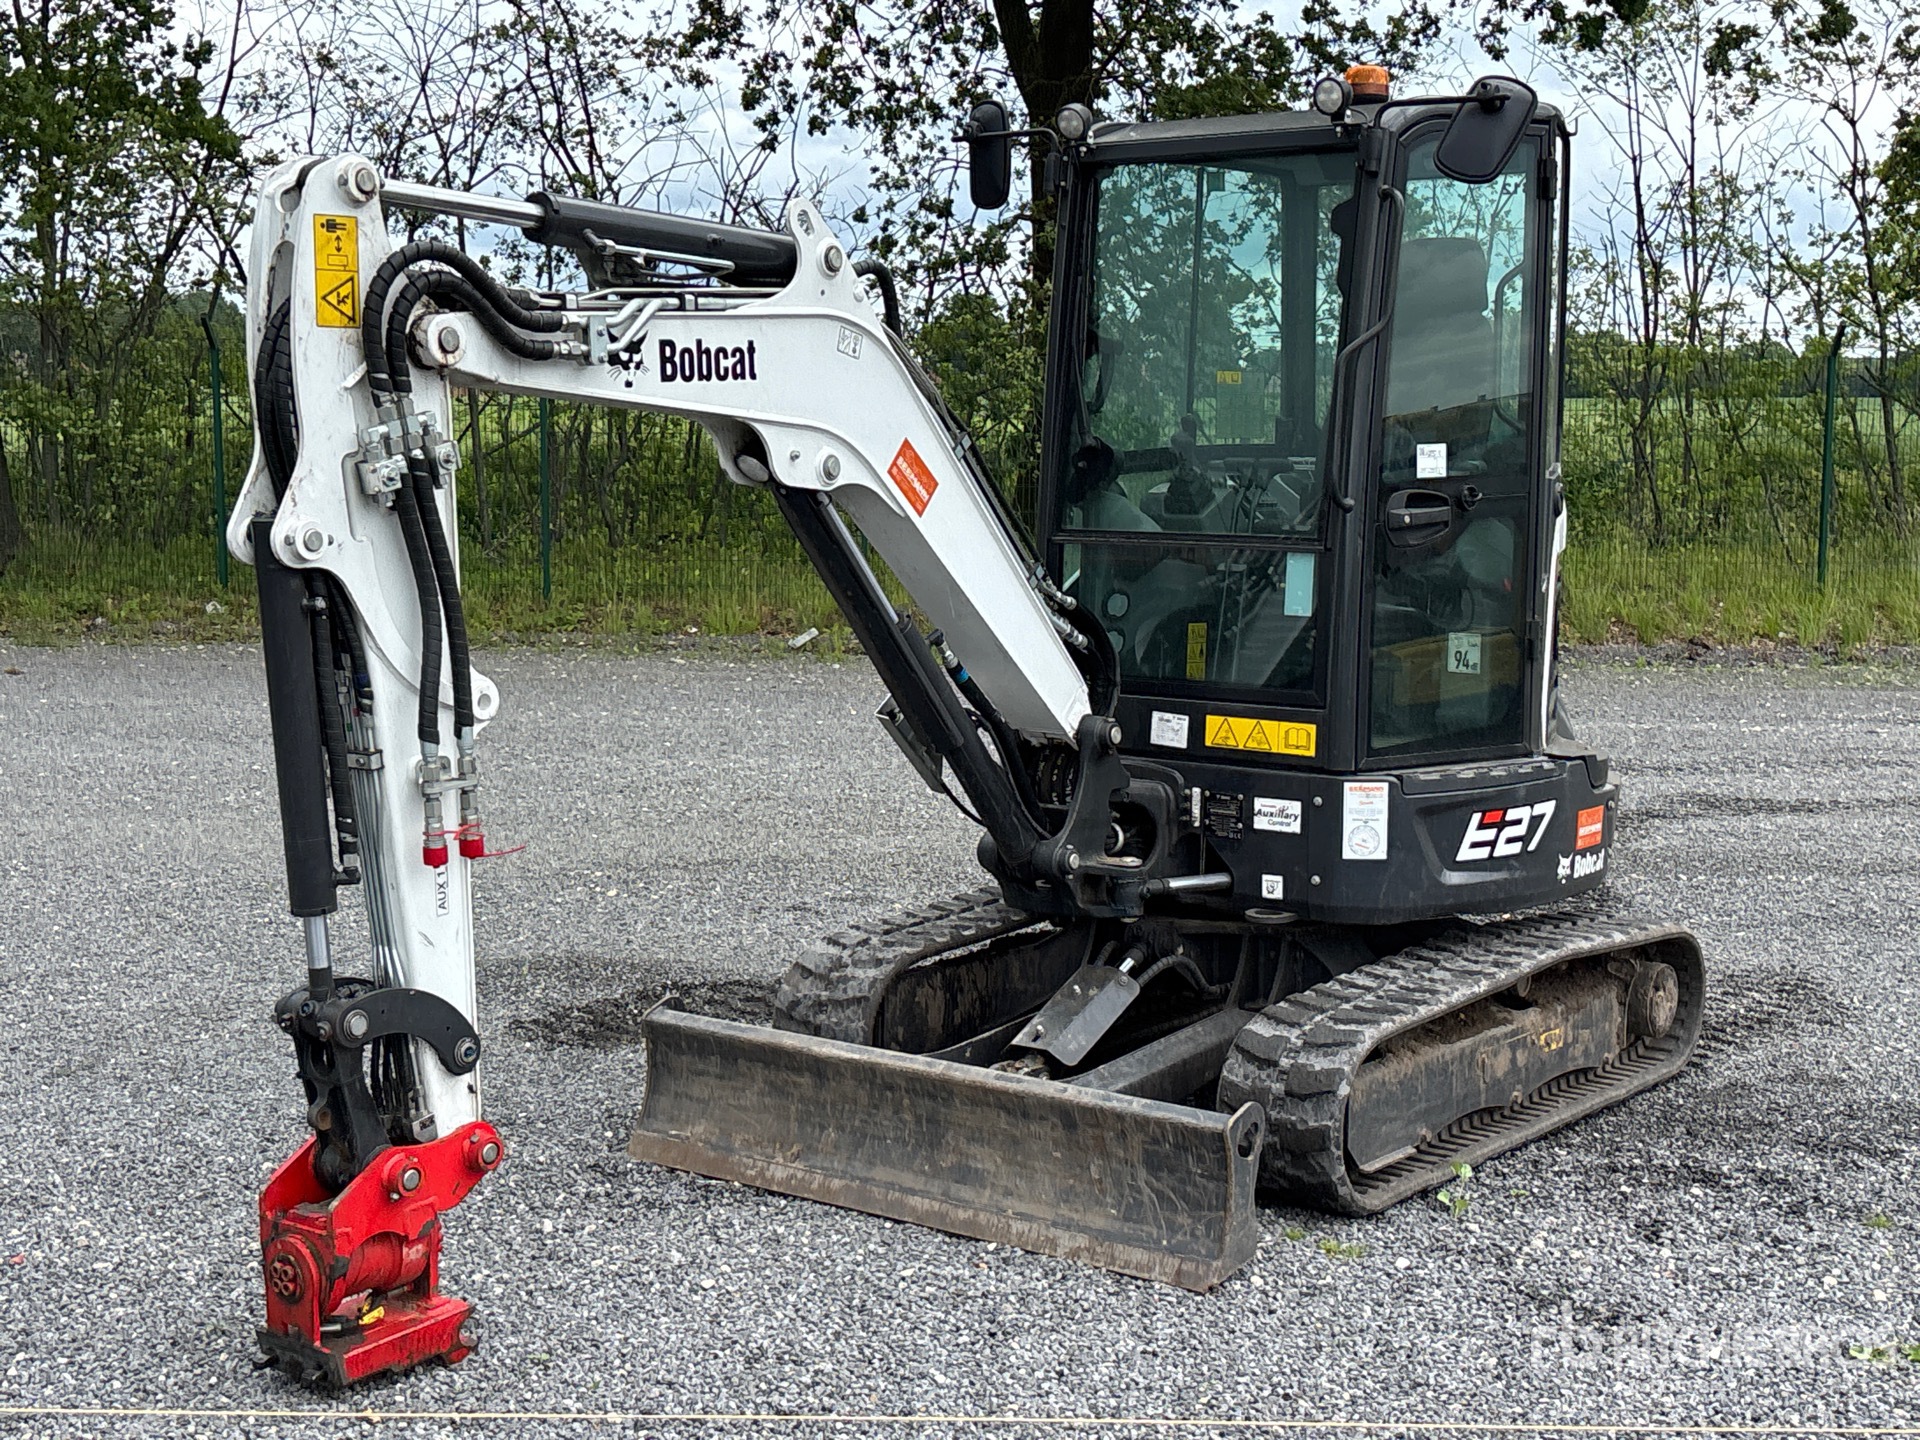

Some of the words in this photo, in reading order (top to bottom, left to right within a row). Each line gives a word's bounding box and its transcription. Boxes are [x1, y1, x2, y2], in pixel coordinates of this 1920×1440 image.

[658, 338, 757, 383] Bobcat
[1454, 650, 1470, 671] 94
[1267, 818, 1292, 828] Control
[1455, 799, 1557, 862] E27
[1572, 847, 1606, 880] Bobcat
[437, 881, 448, 910] AUX
